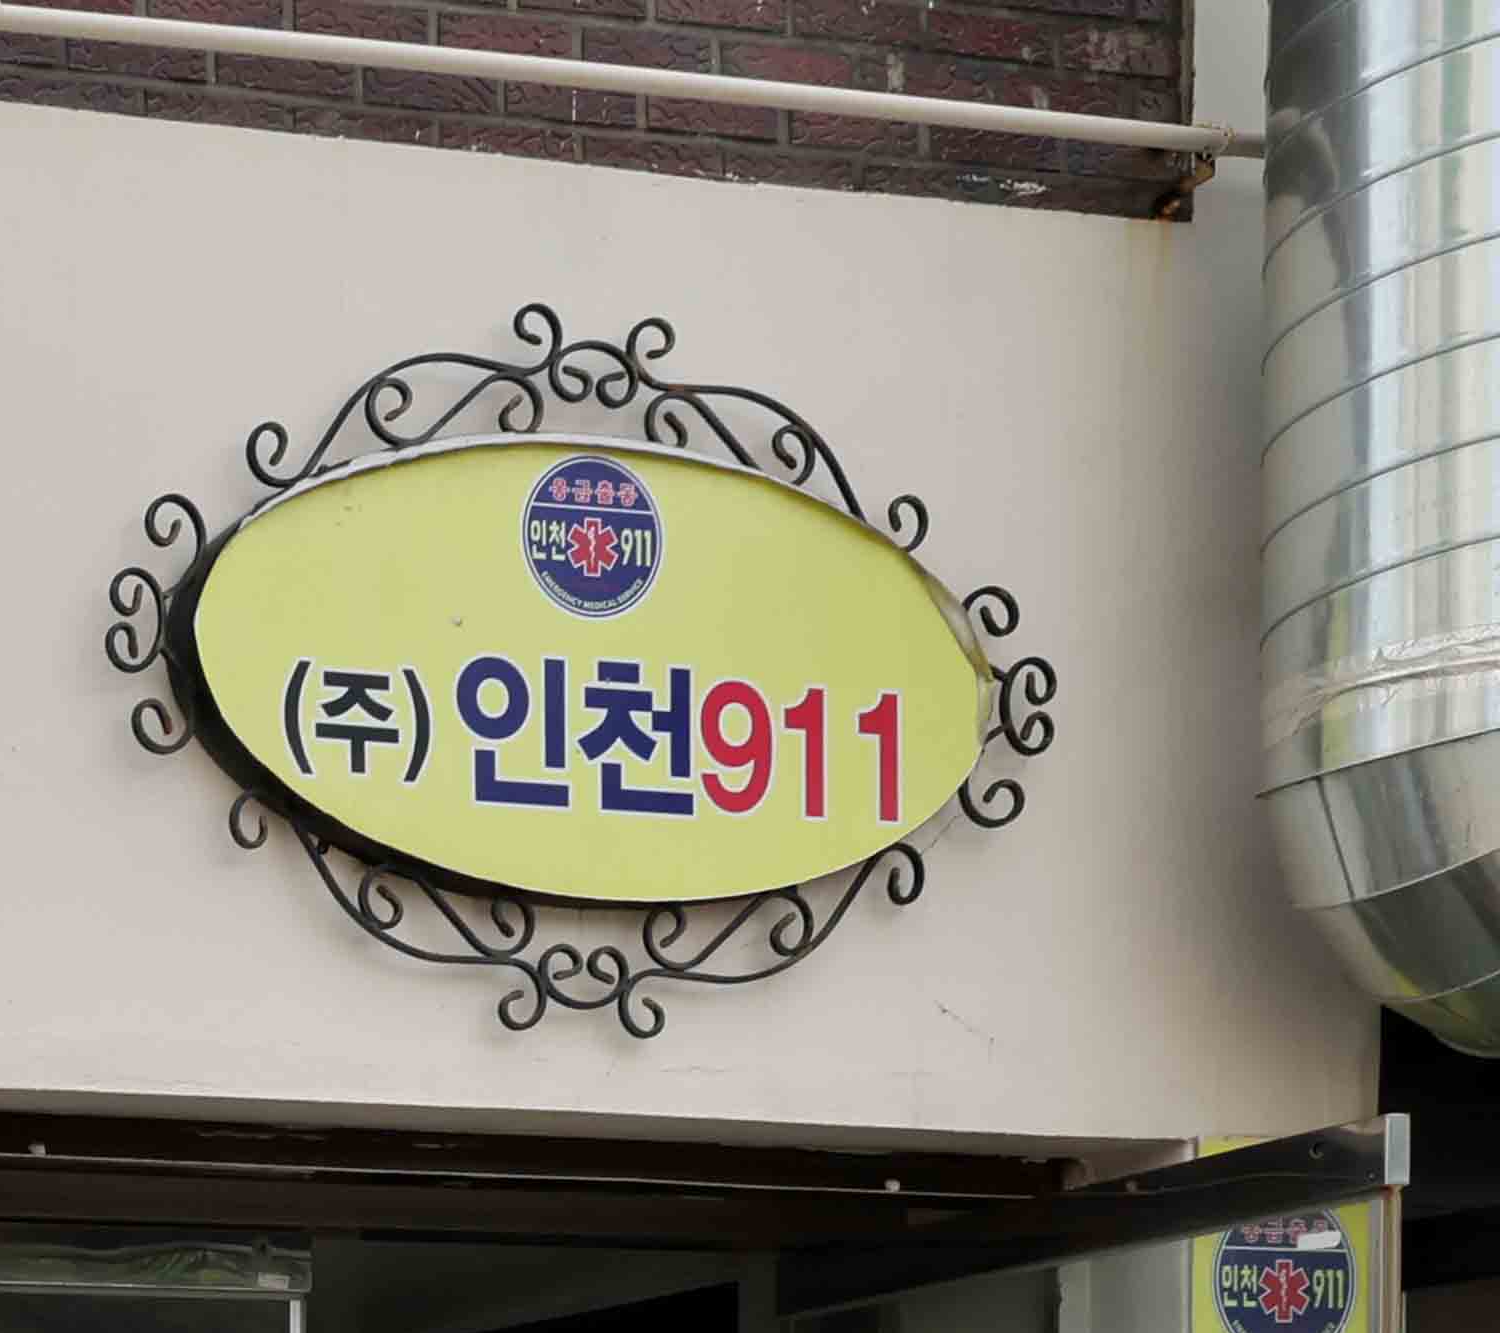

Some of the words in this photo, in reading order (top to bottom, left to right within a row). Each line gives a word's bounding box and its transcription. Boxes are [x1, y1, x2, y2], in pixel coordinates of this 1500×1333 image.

[530, 519, 566, 561] 인천
[620, 528, 652, 567] 911
[283, 658, 431, 783] (주)
[1221, 1263, 1258, 1307] 인천
[1312, 1269, 1345, 1309] 911
